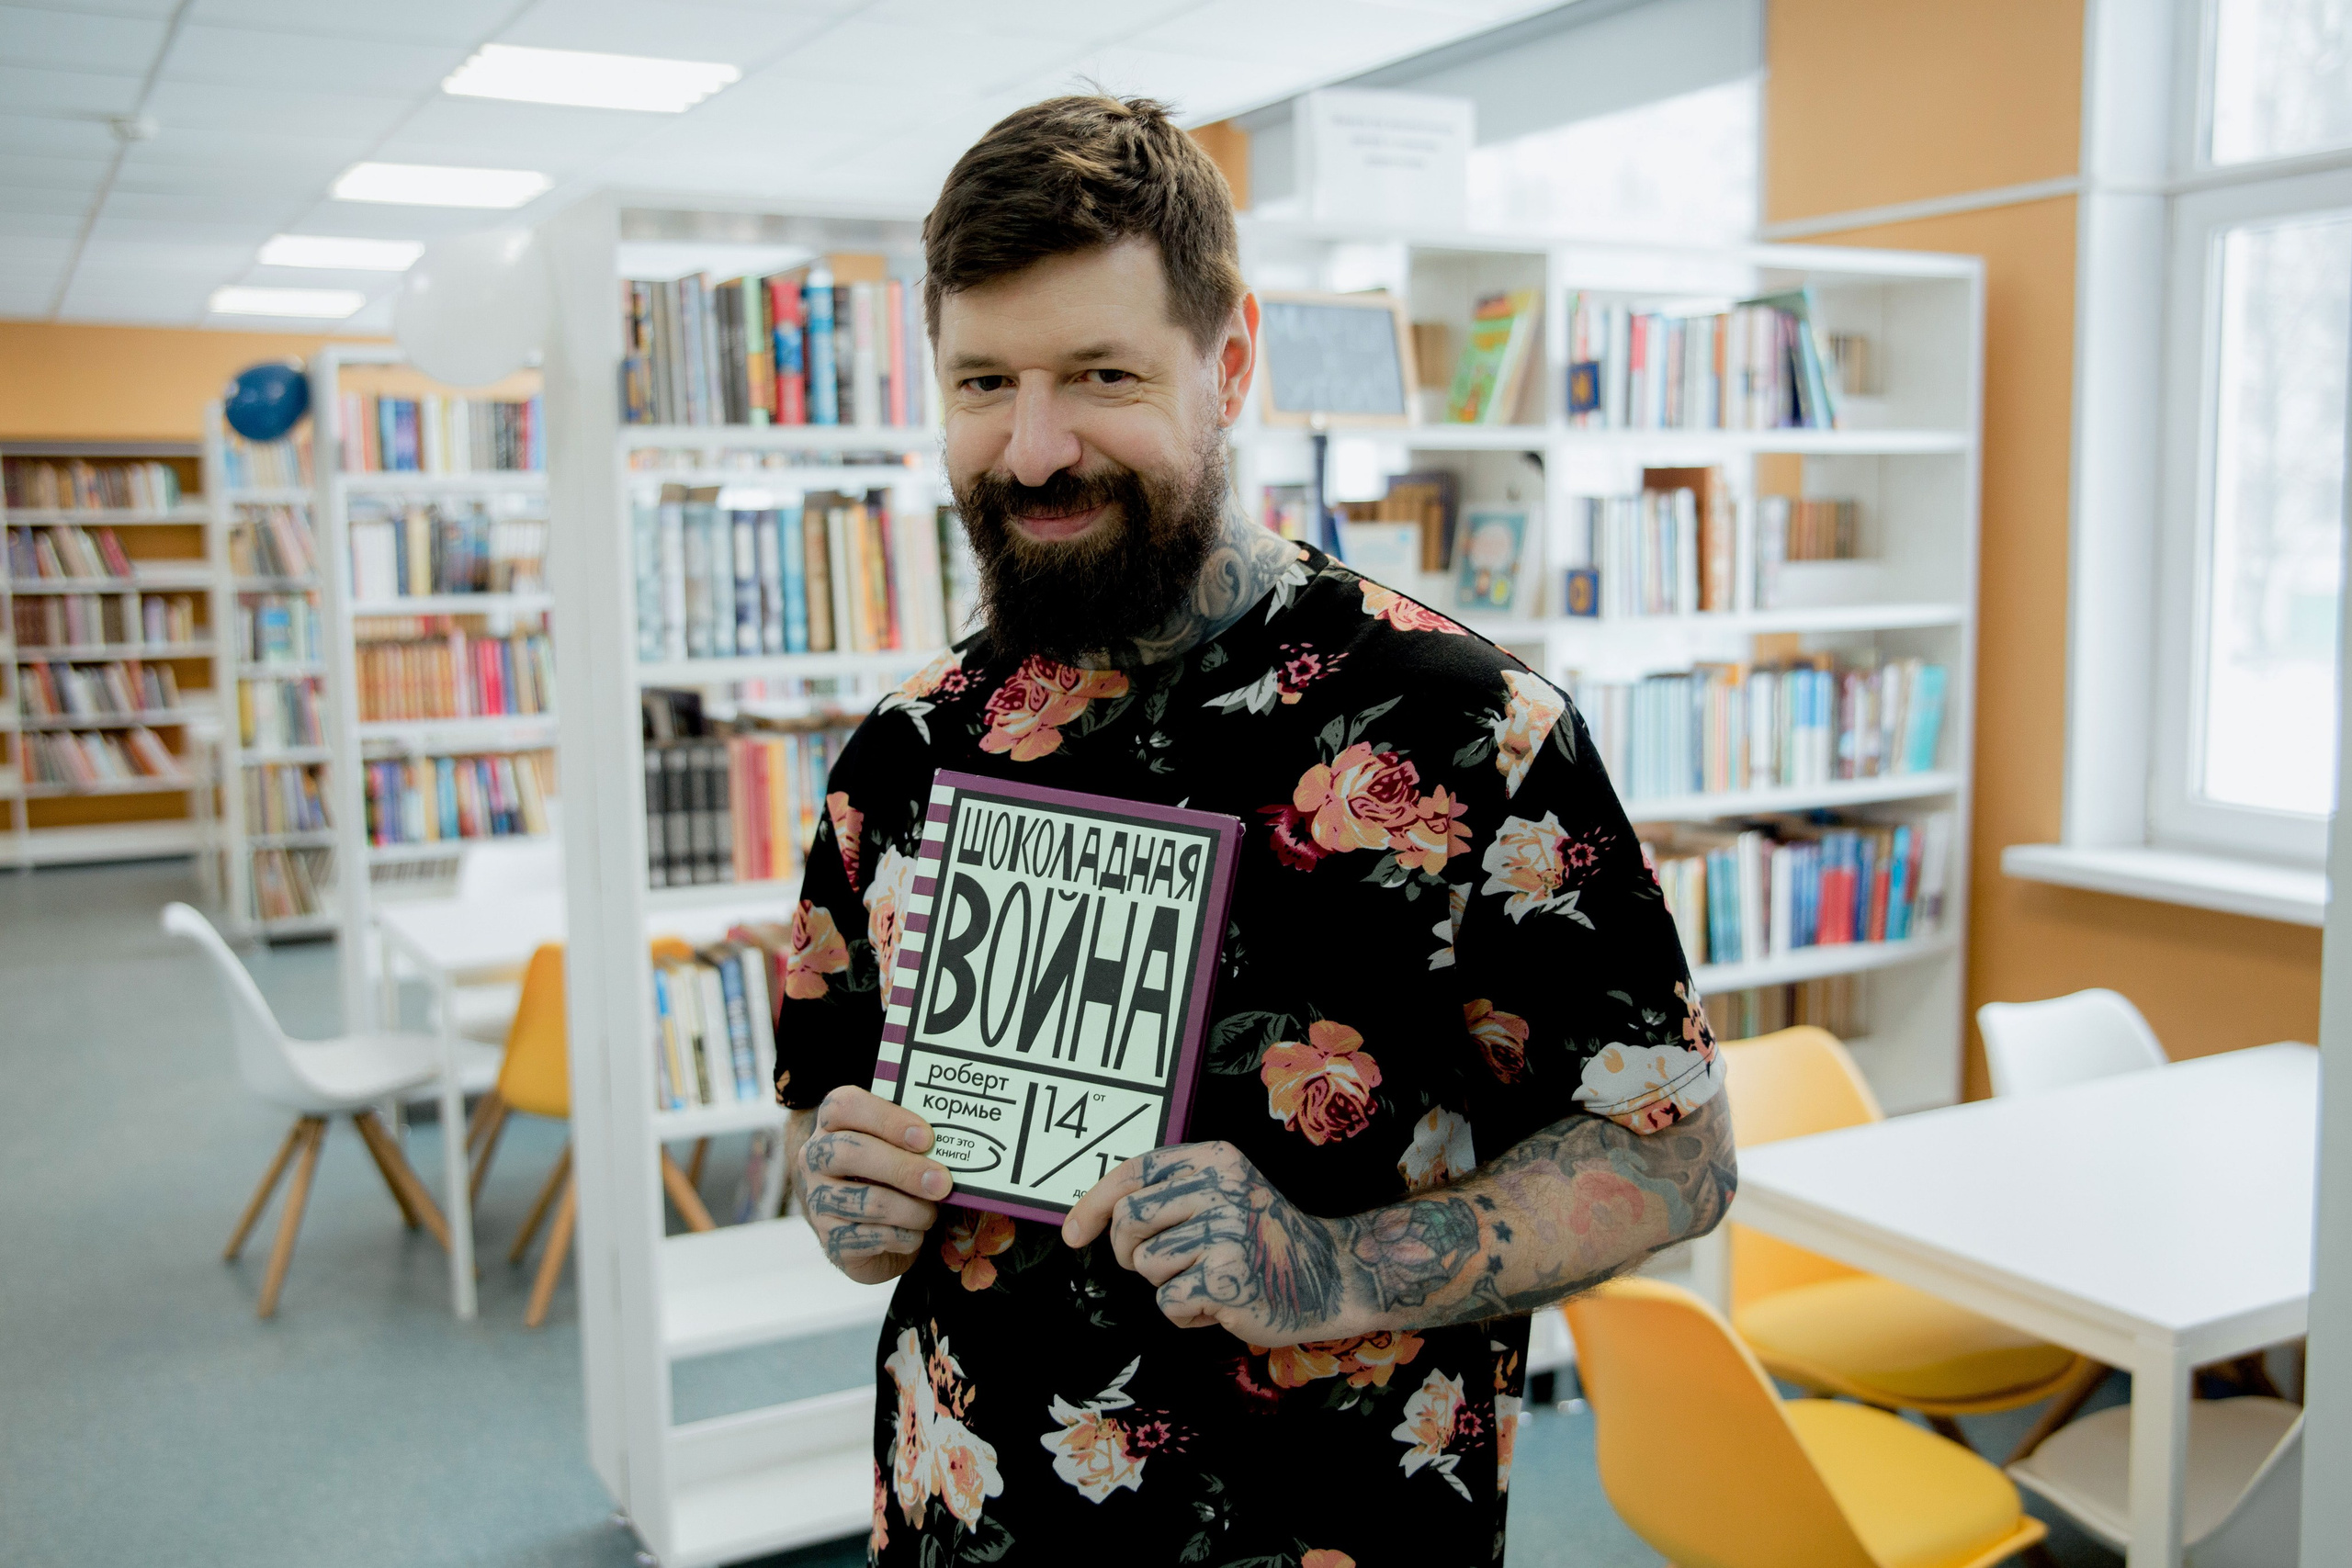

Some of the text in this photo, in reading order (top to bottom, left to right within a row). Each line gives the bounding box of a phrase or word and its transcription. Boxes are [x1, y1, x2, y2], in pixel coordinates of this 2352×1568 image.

[956, 807, 1203, 901] ШОКОЛАДНАЯ
[923, 872, 1180, 1078] ВОЙНА
[927, 1062, 1010, 1095] роберт
[922, 1094, 1002, 1122] кормье
[1045, 1085, 1106, 1139] 14 от
[935, 1148, 971, 1161] книга!
[936, 1134, 976, 1148] вот это
[1095, 1152, 1130, 1181] 1
